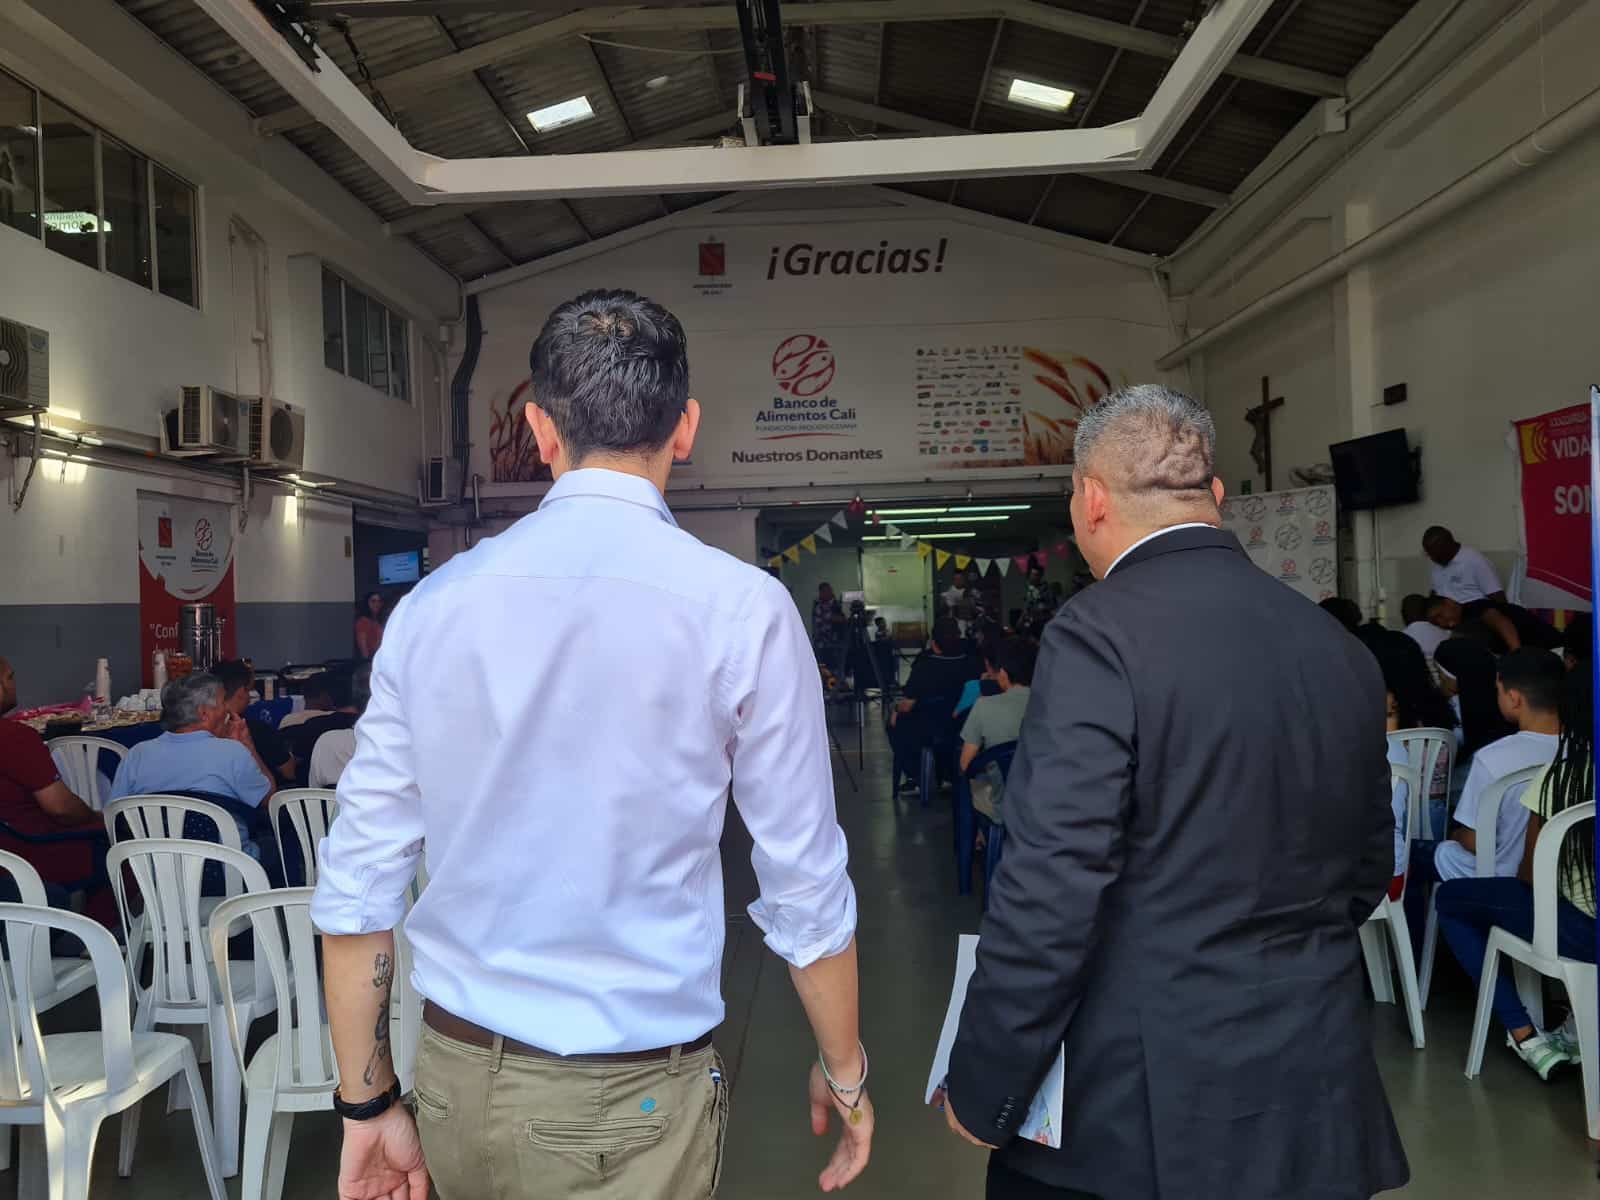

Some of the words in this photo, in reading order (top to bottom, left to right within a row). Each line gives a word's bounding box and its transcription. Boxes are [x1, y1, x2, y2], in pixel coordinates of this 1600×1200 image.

[767, 238, 947, 280] ¡Gracias!
[773, 398, 818, 409] Banco
[820, 396, 837, 408] de
[755, 411, 827, 422] Alimentos
[829, 408, 856, 420] Cali
[732, 450, 804, 463] Nuestros
[806, 449, 883, 462] Donantes
